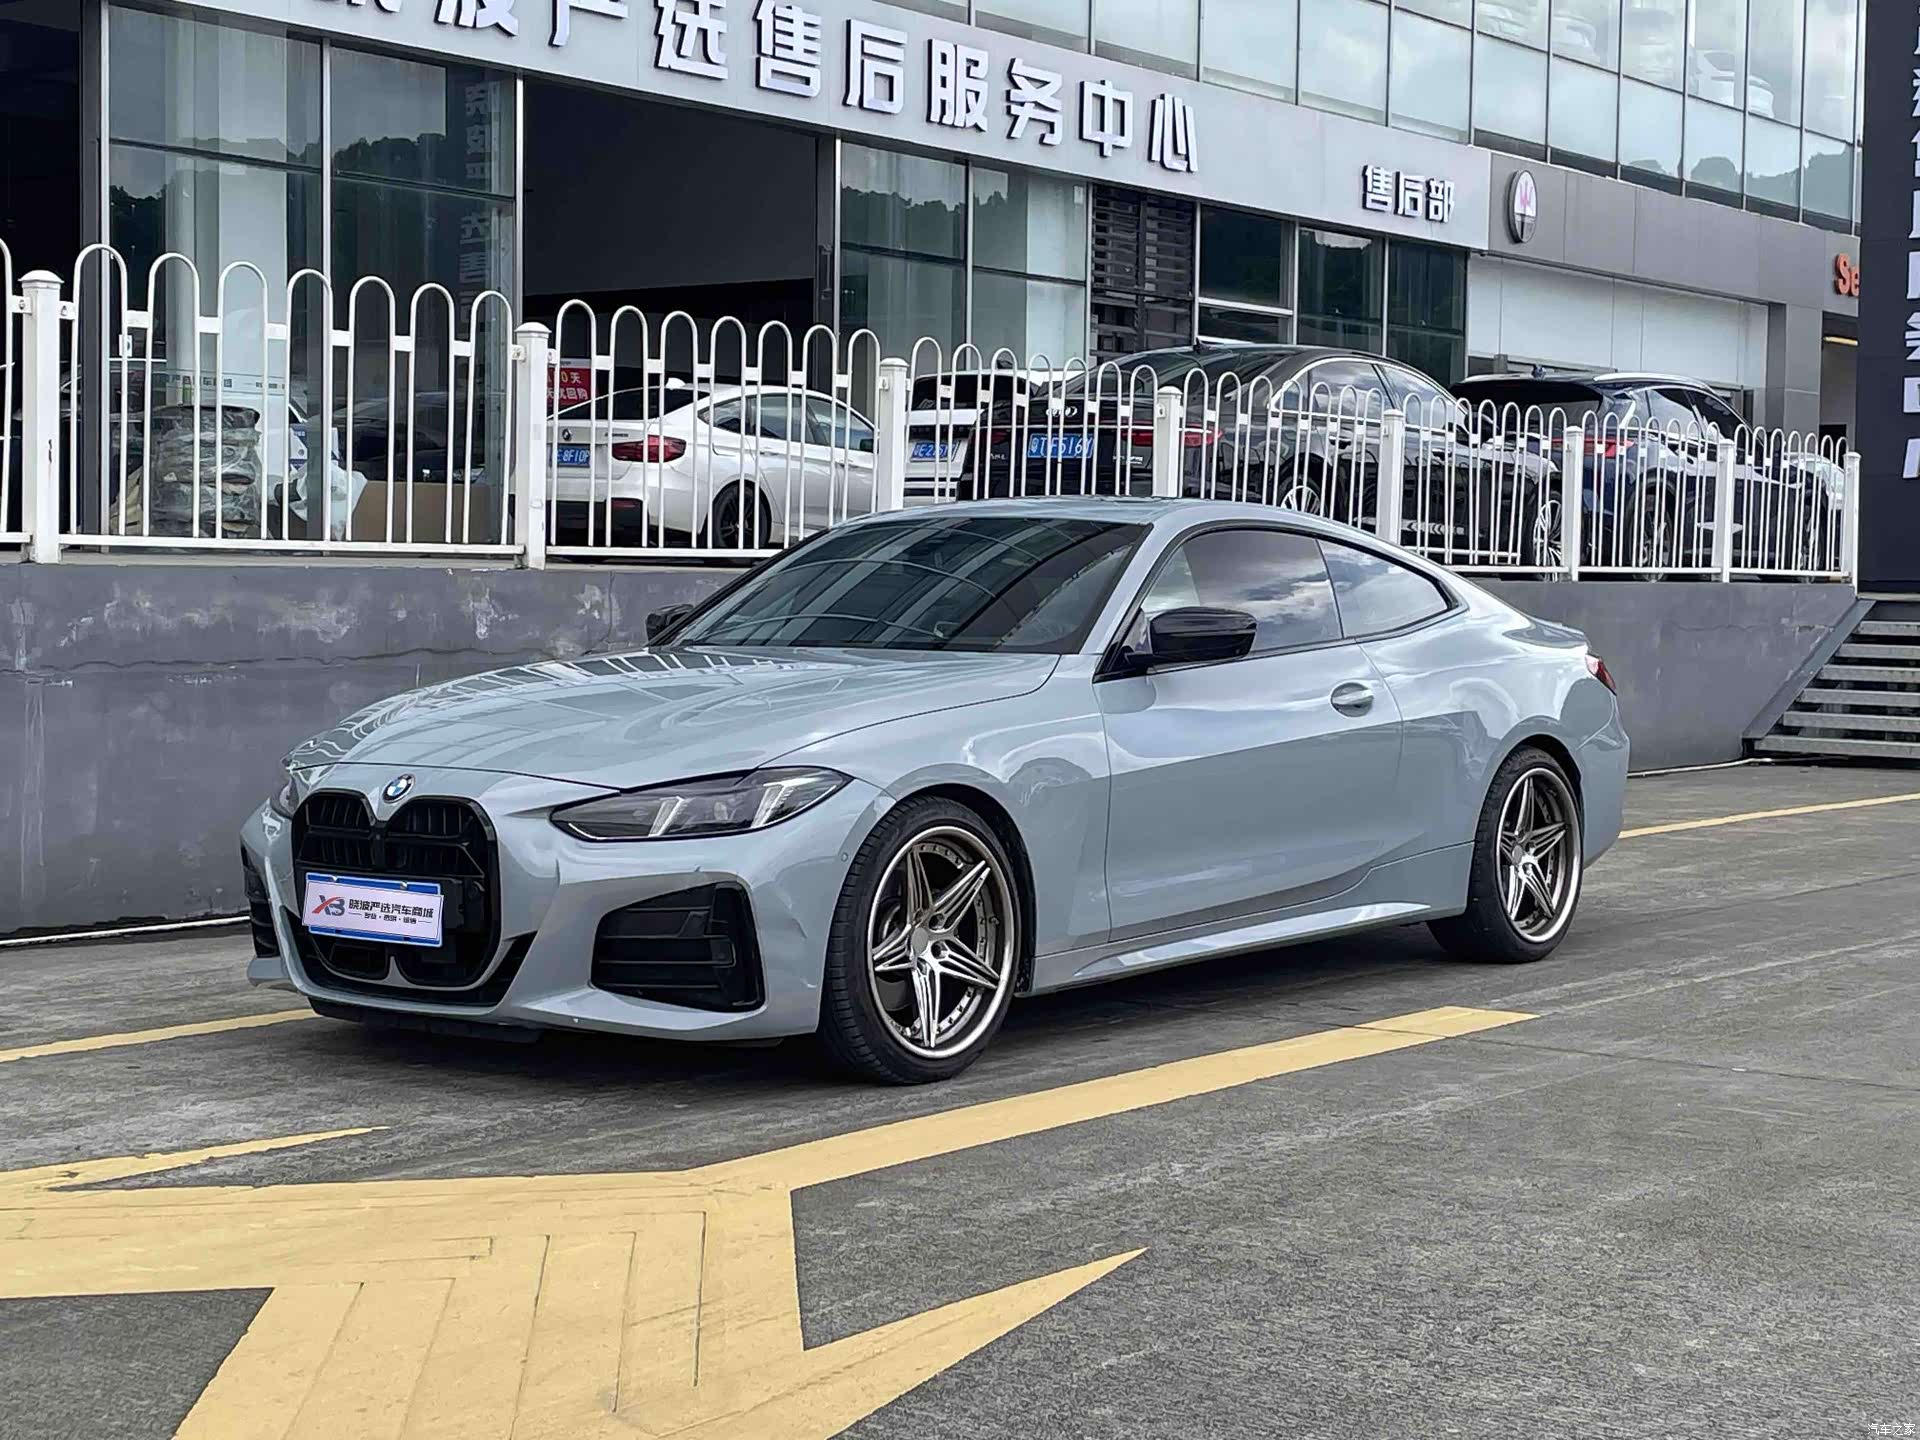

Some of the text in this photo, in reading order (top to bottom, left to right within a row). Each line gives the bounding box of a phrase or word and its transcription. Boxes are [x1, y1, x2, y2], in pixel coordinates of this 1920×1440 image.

[1362, 165, 1455, 223] 售后部
[348, 898, 434, 918] 晓波严选汽车商城
